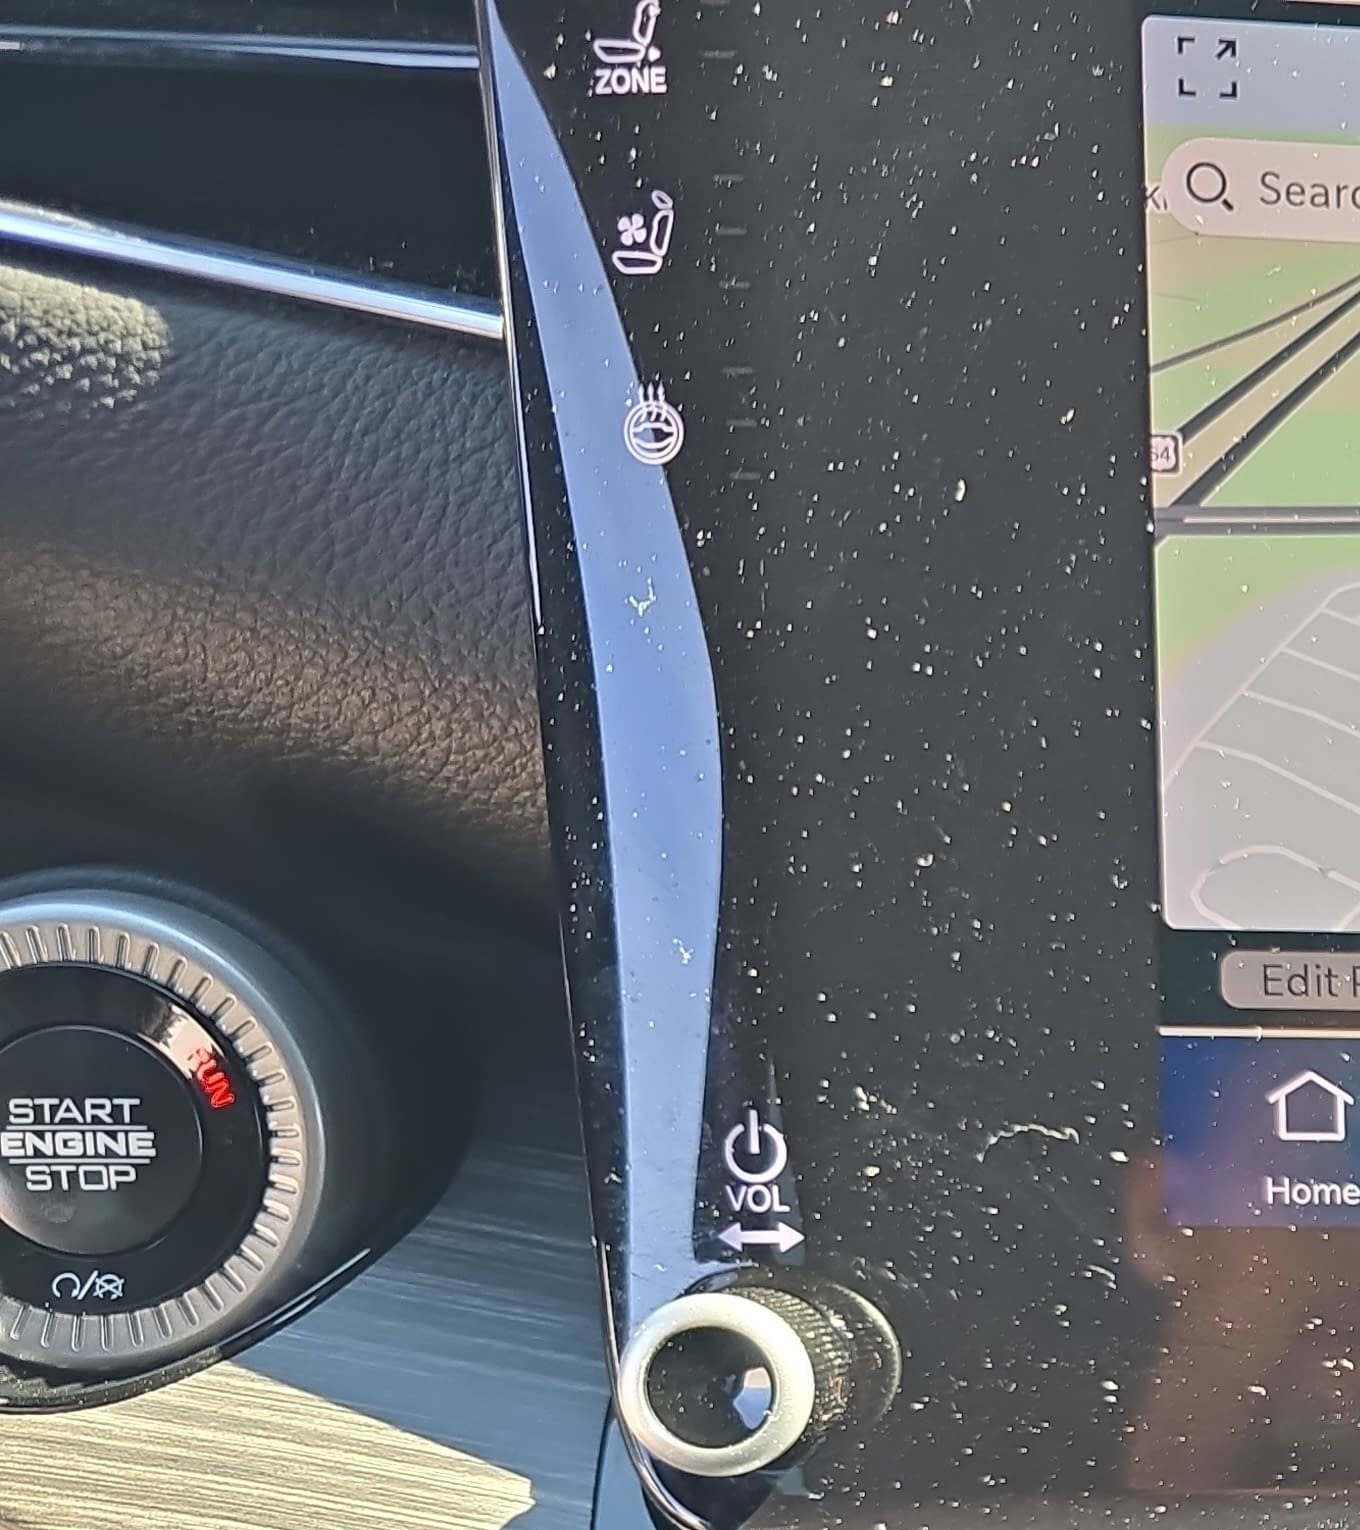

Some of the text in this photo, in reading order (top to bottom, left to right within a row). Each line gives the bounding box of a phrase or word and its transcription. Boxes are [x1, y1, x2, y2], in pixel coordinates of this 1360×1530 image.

[595, 66, 667, 95] ZONE
[1262, 963, 1339, 998] Edit
[8, 1098, 141, 1125] START
[0, 1131, 157, 1157] ENGINE
[25, 1164, 138, 1192] STOP
[726, 1183, 791, 1214] VOL
